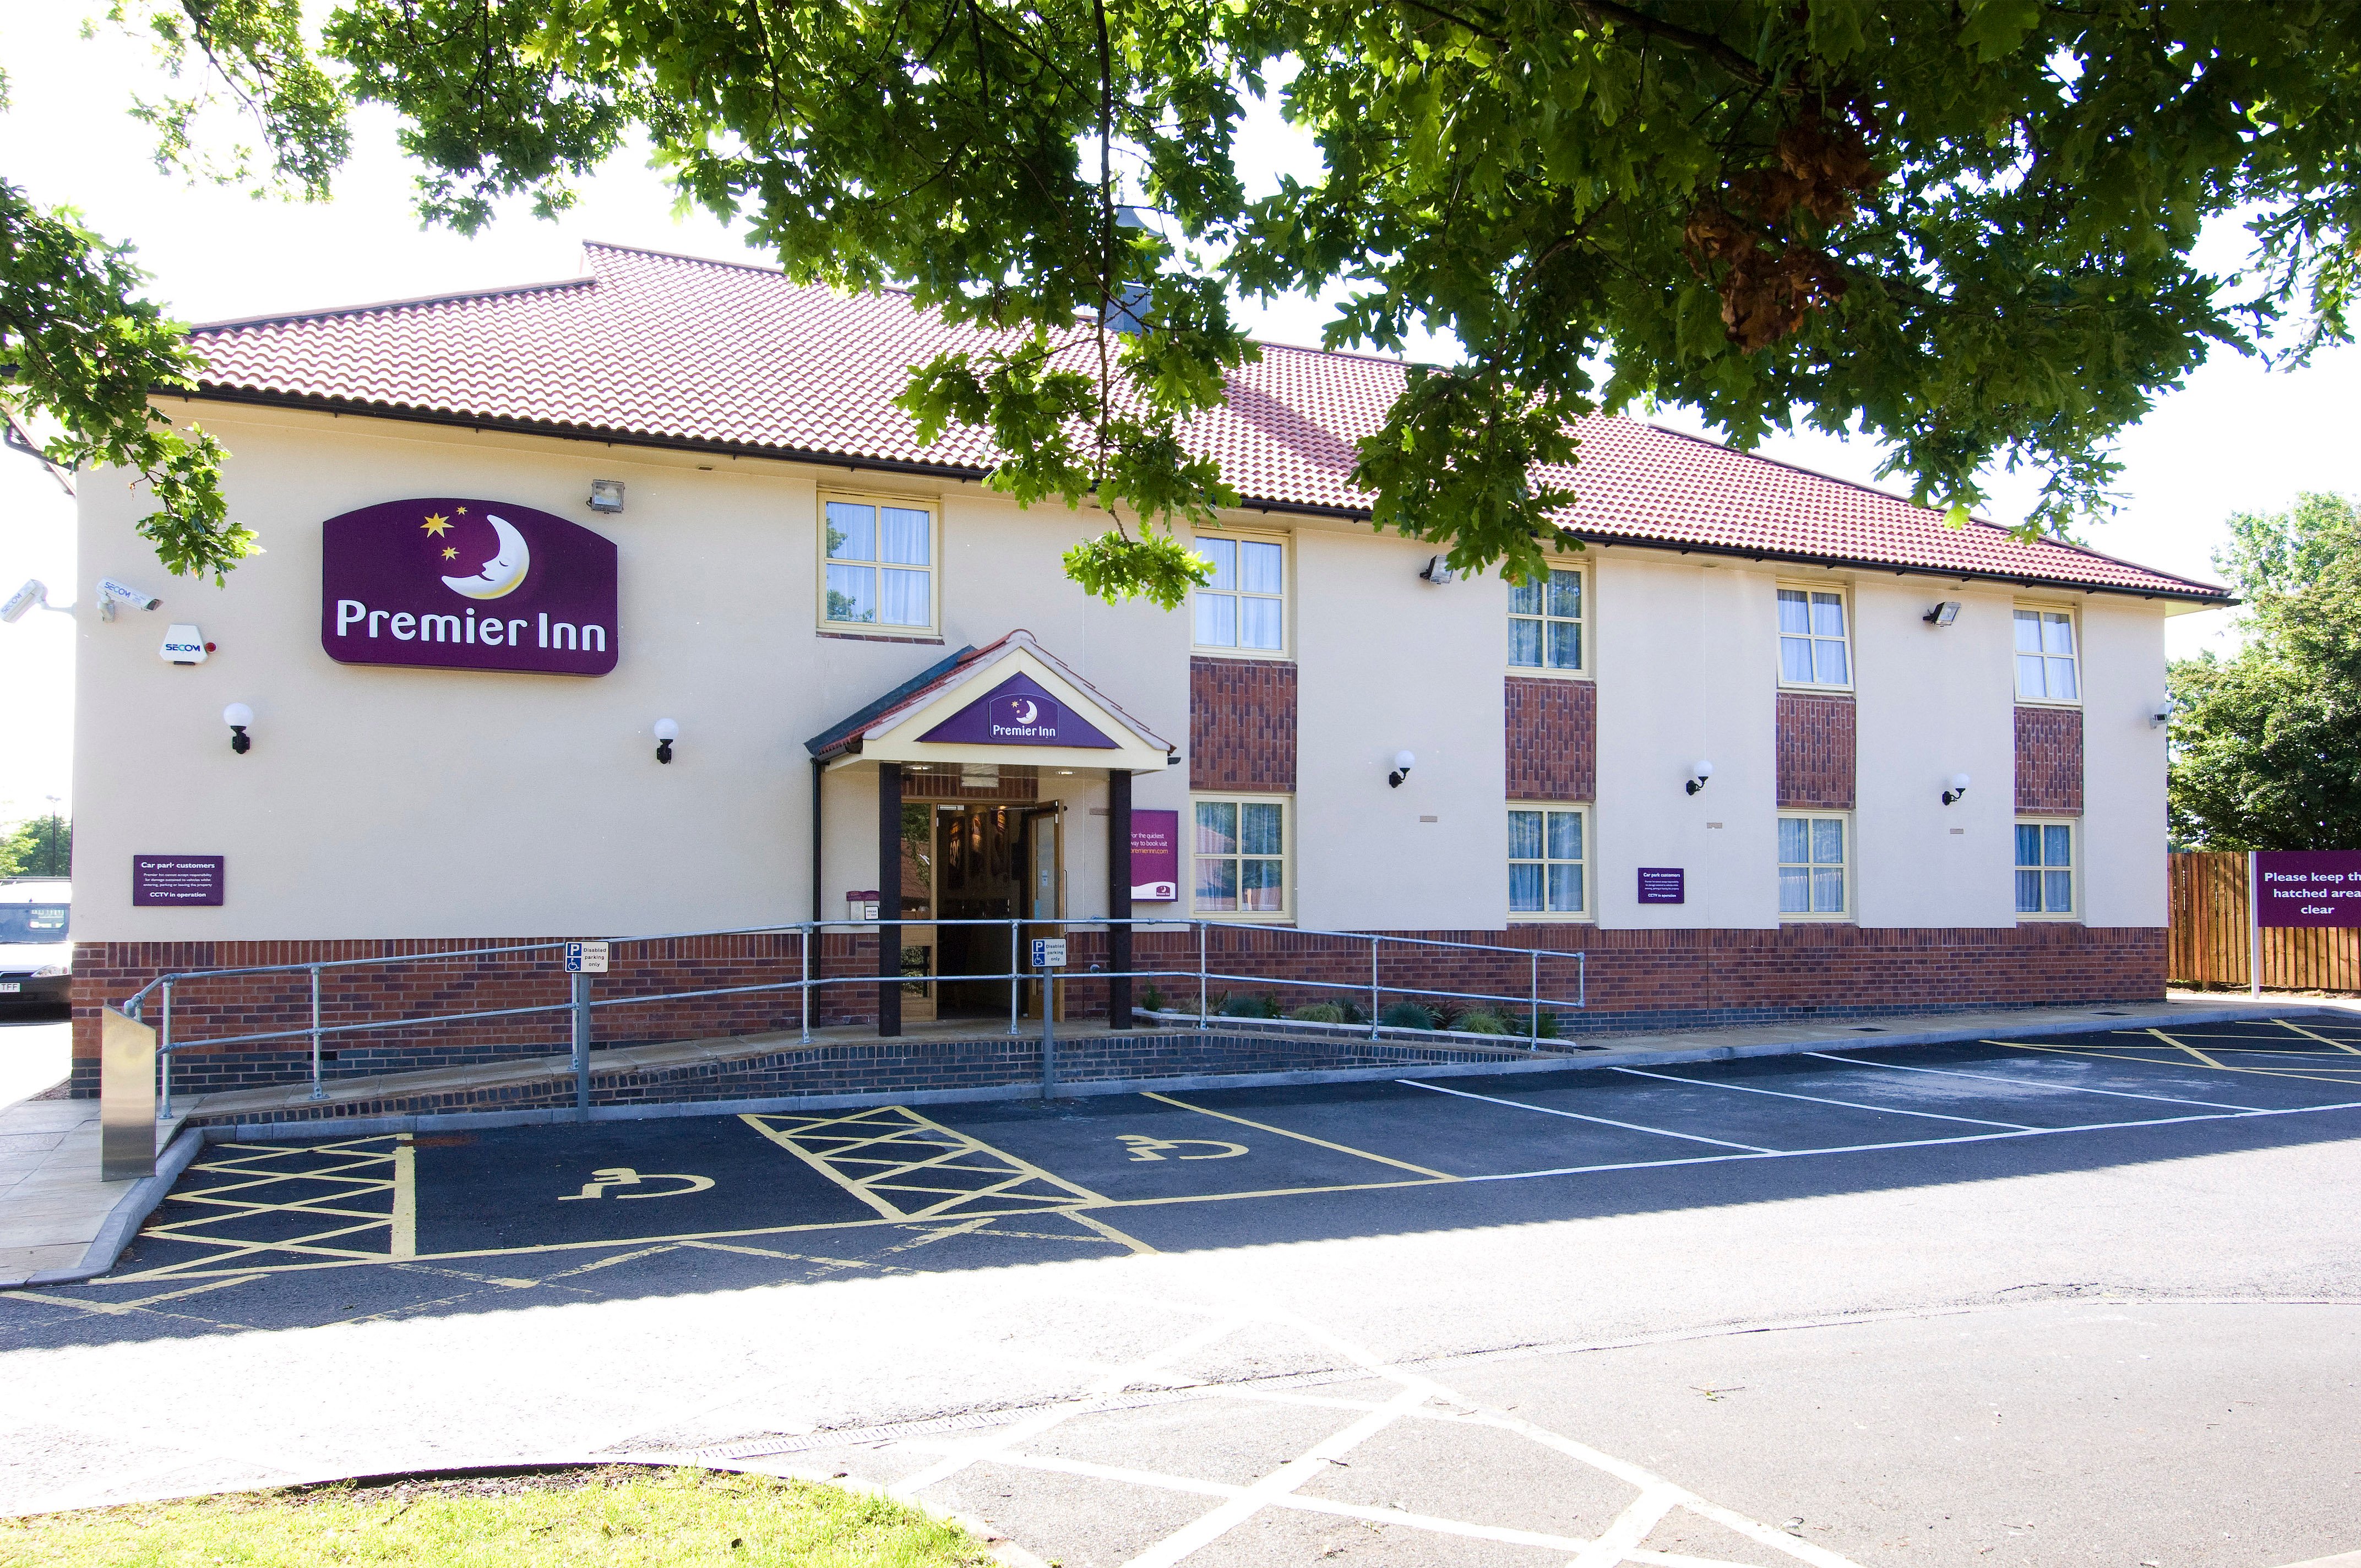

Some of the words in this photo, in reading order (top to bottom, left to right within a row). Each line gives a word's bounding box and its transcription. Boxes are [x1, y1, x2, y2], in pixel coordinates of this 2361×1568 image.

[105, 582, 130, 598] SECOM
[337, 600, 527, 646] Premier
[538, 612, 605, 651] Inn
[166, 644, 200, 652] SECOM
[993, 725, 1037, 736] Premier
[1039, 726, 1056, 737] Inn
[2264, 872, 2307, 881] Please
[2311, 872, 2344, 884] keep
[2273, 889, 2327, 898] hatched
[2300, 905, 2335, 914] clear
[570, 944, 580, 956] P
[1036, 941, 1043, 952] P
